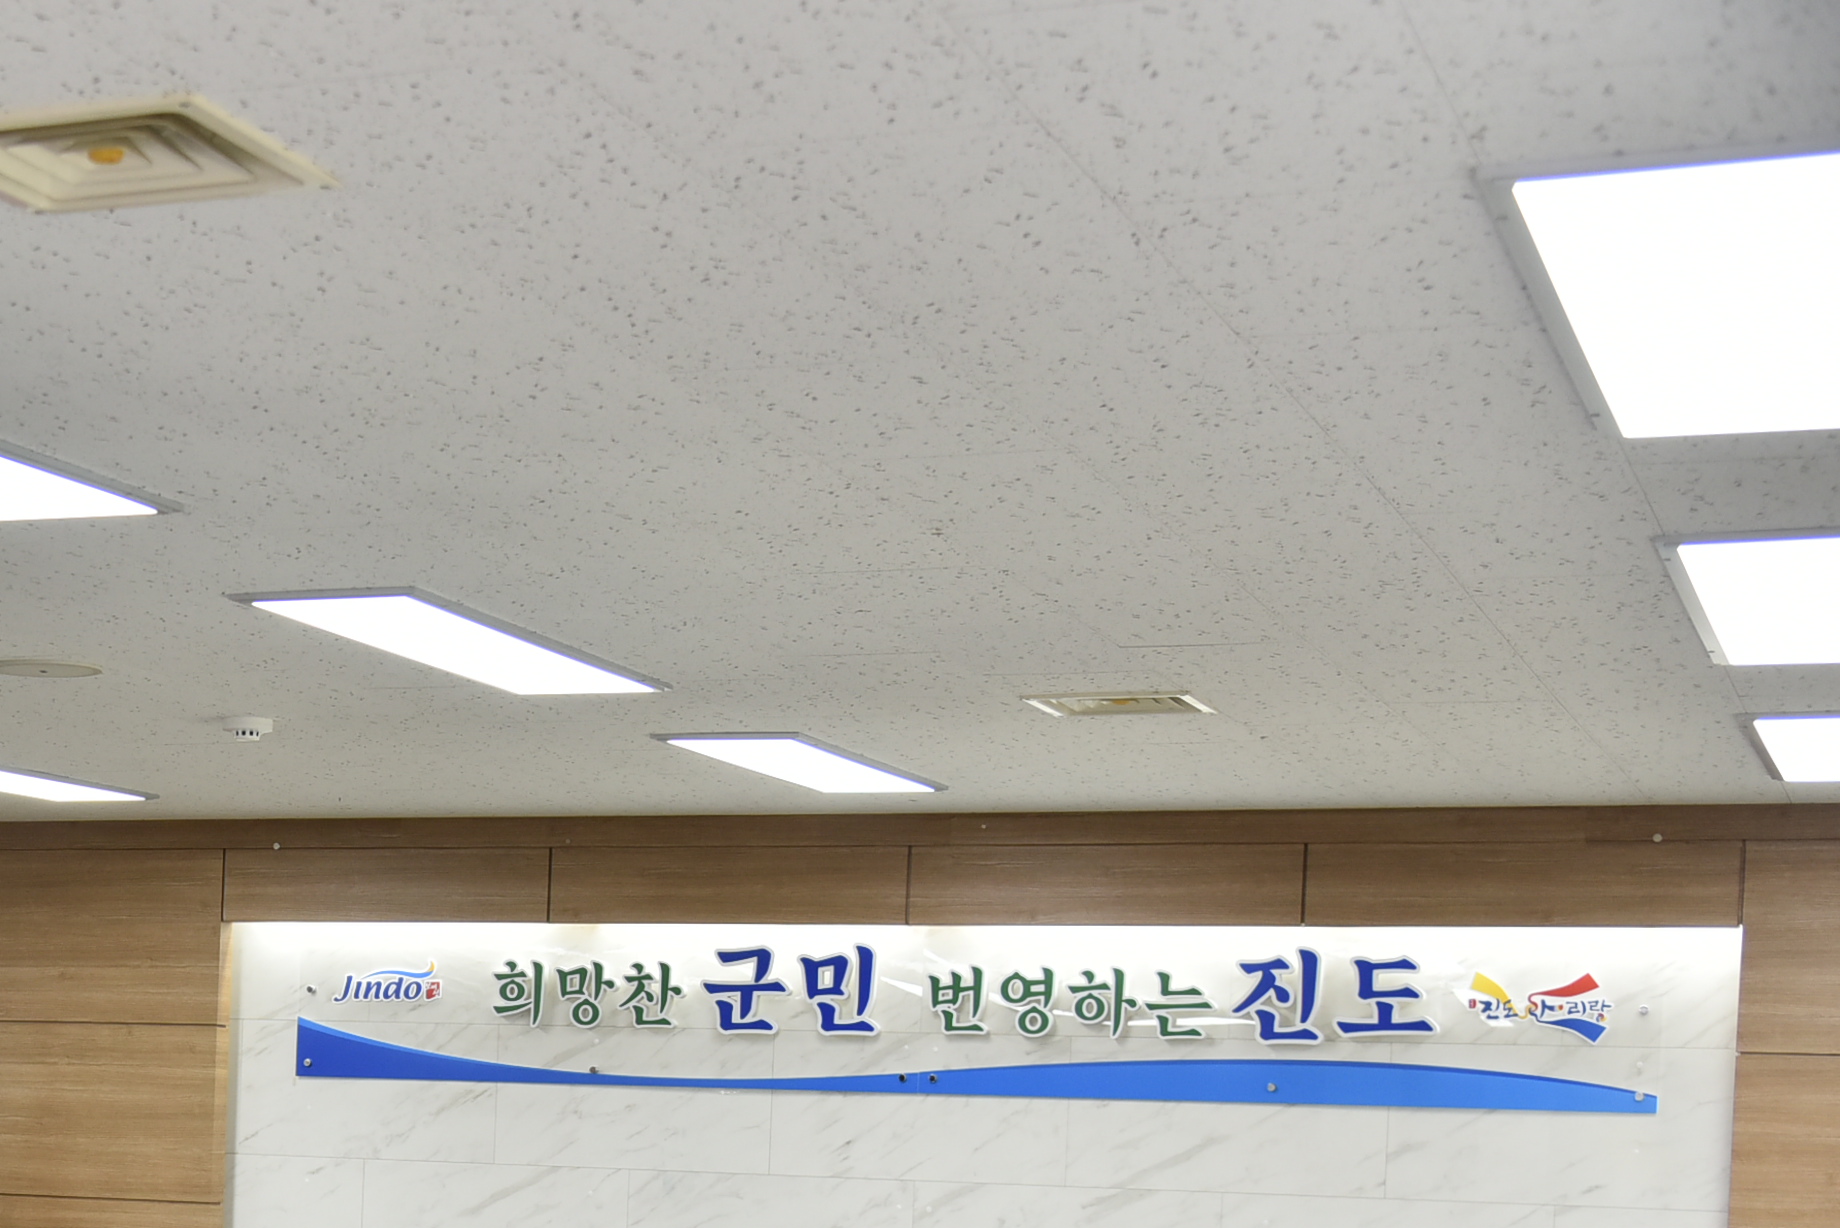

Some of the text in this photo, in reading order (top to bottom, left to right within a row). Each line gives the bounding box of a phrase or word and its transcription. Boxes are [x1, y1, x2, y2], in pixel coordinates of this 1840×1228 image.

[332, 974, 423, 1003] Jindo
[493, 944, 1437, 1042] 희망찬 군민 번영하는 진도
